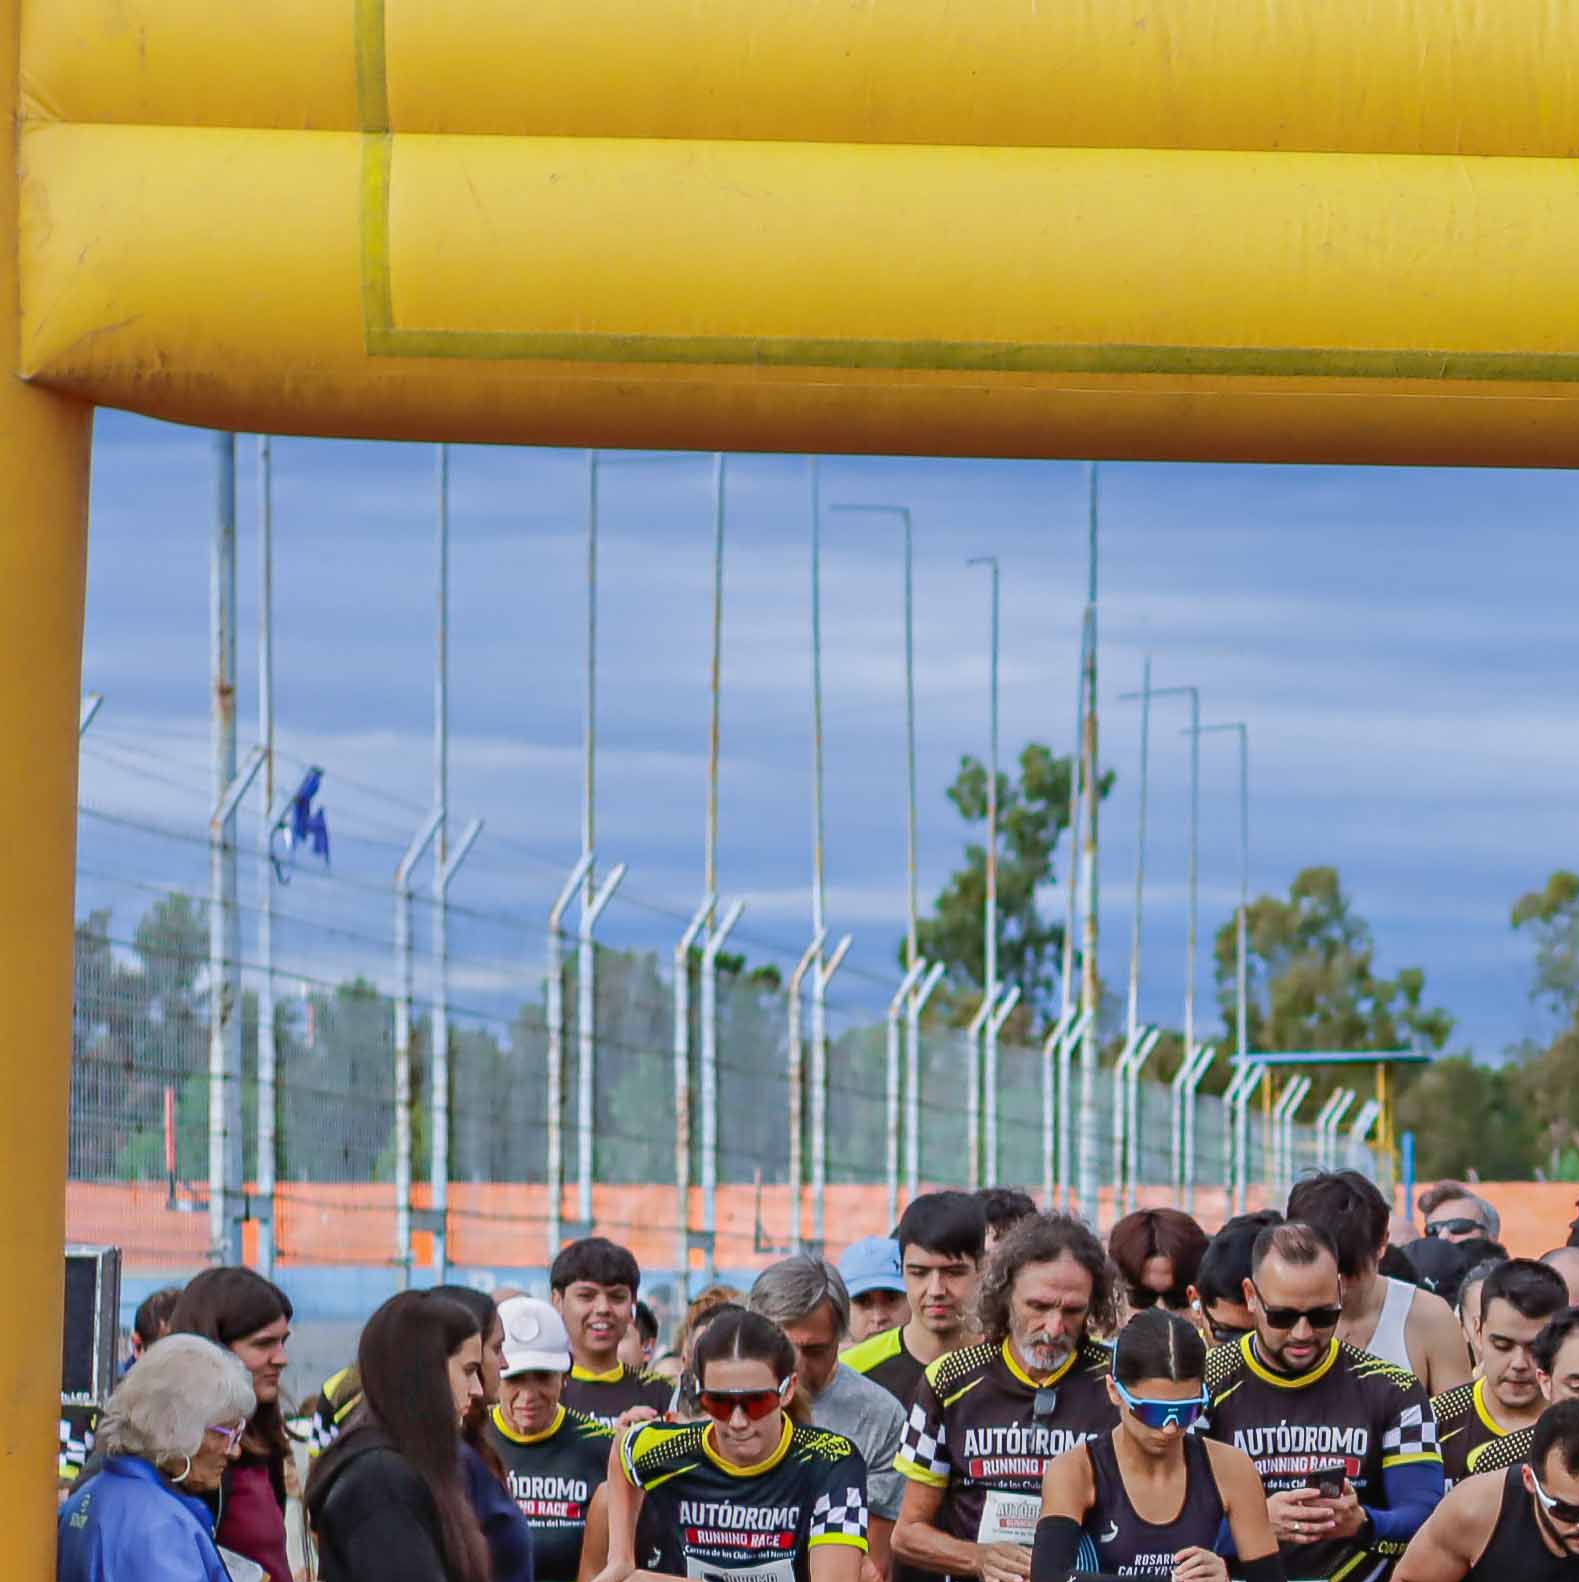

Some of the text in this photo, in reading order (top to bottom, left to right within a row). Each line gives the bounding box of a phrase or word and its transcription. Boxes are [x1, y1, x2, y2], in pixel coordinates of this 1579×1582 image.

[963, 1421, 1098, 1457] AUTÓDROM
[1234, 1419, 1367, 1456] AUTÓDROMO
[983, 1458, 1038, 1476] RUNNING
[1255, 1457, 1307, 1474] RUNNING
[507, 1470, 588, 1500] ÓDROMO
[539, 1500, 568, 1518] RACE
[697, 1529, 780, 1549] RUNNING RACE
[1135, 1554, 1181, 1566] ROSARI
